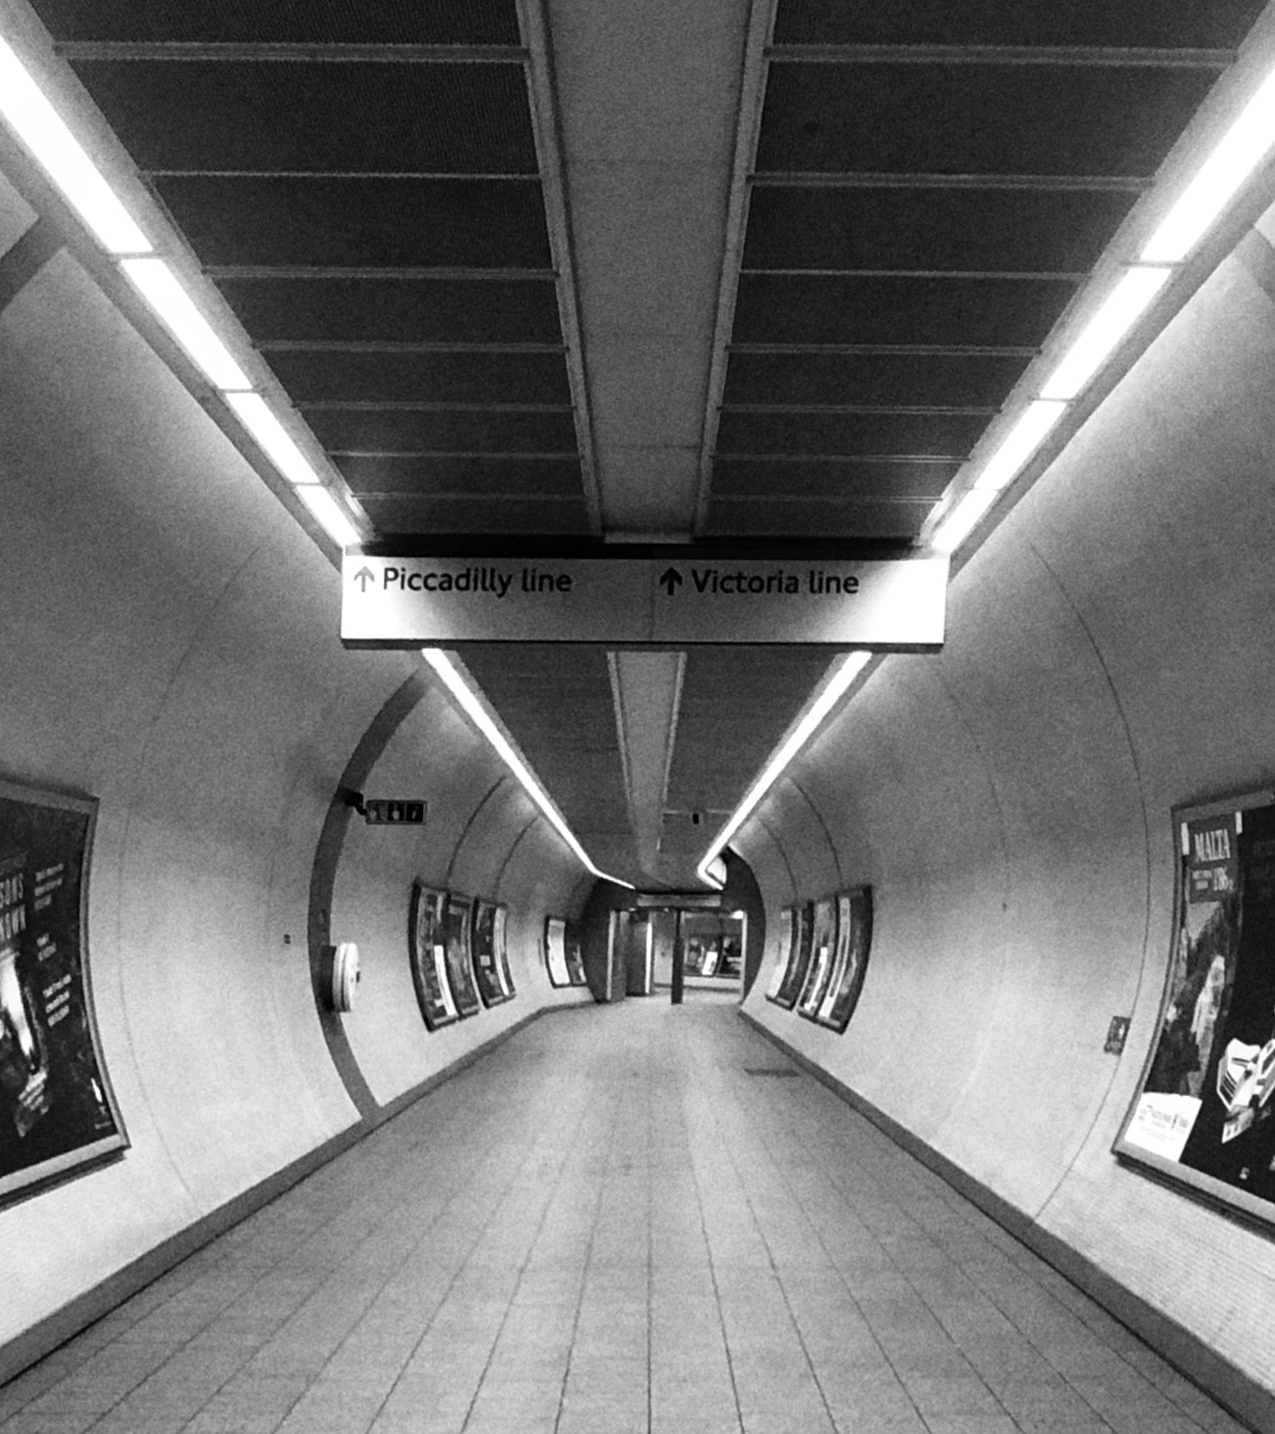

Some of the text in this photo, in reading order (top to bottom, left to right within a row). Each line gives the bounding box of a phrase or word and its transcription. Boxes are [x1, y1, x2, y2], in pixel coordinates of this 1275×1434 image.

[382, 566, 573, 598] Piccadilly line
[691, 568, 860, 595] Victoria line
